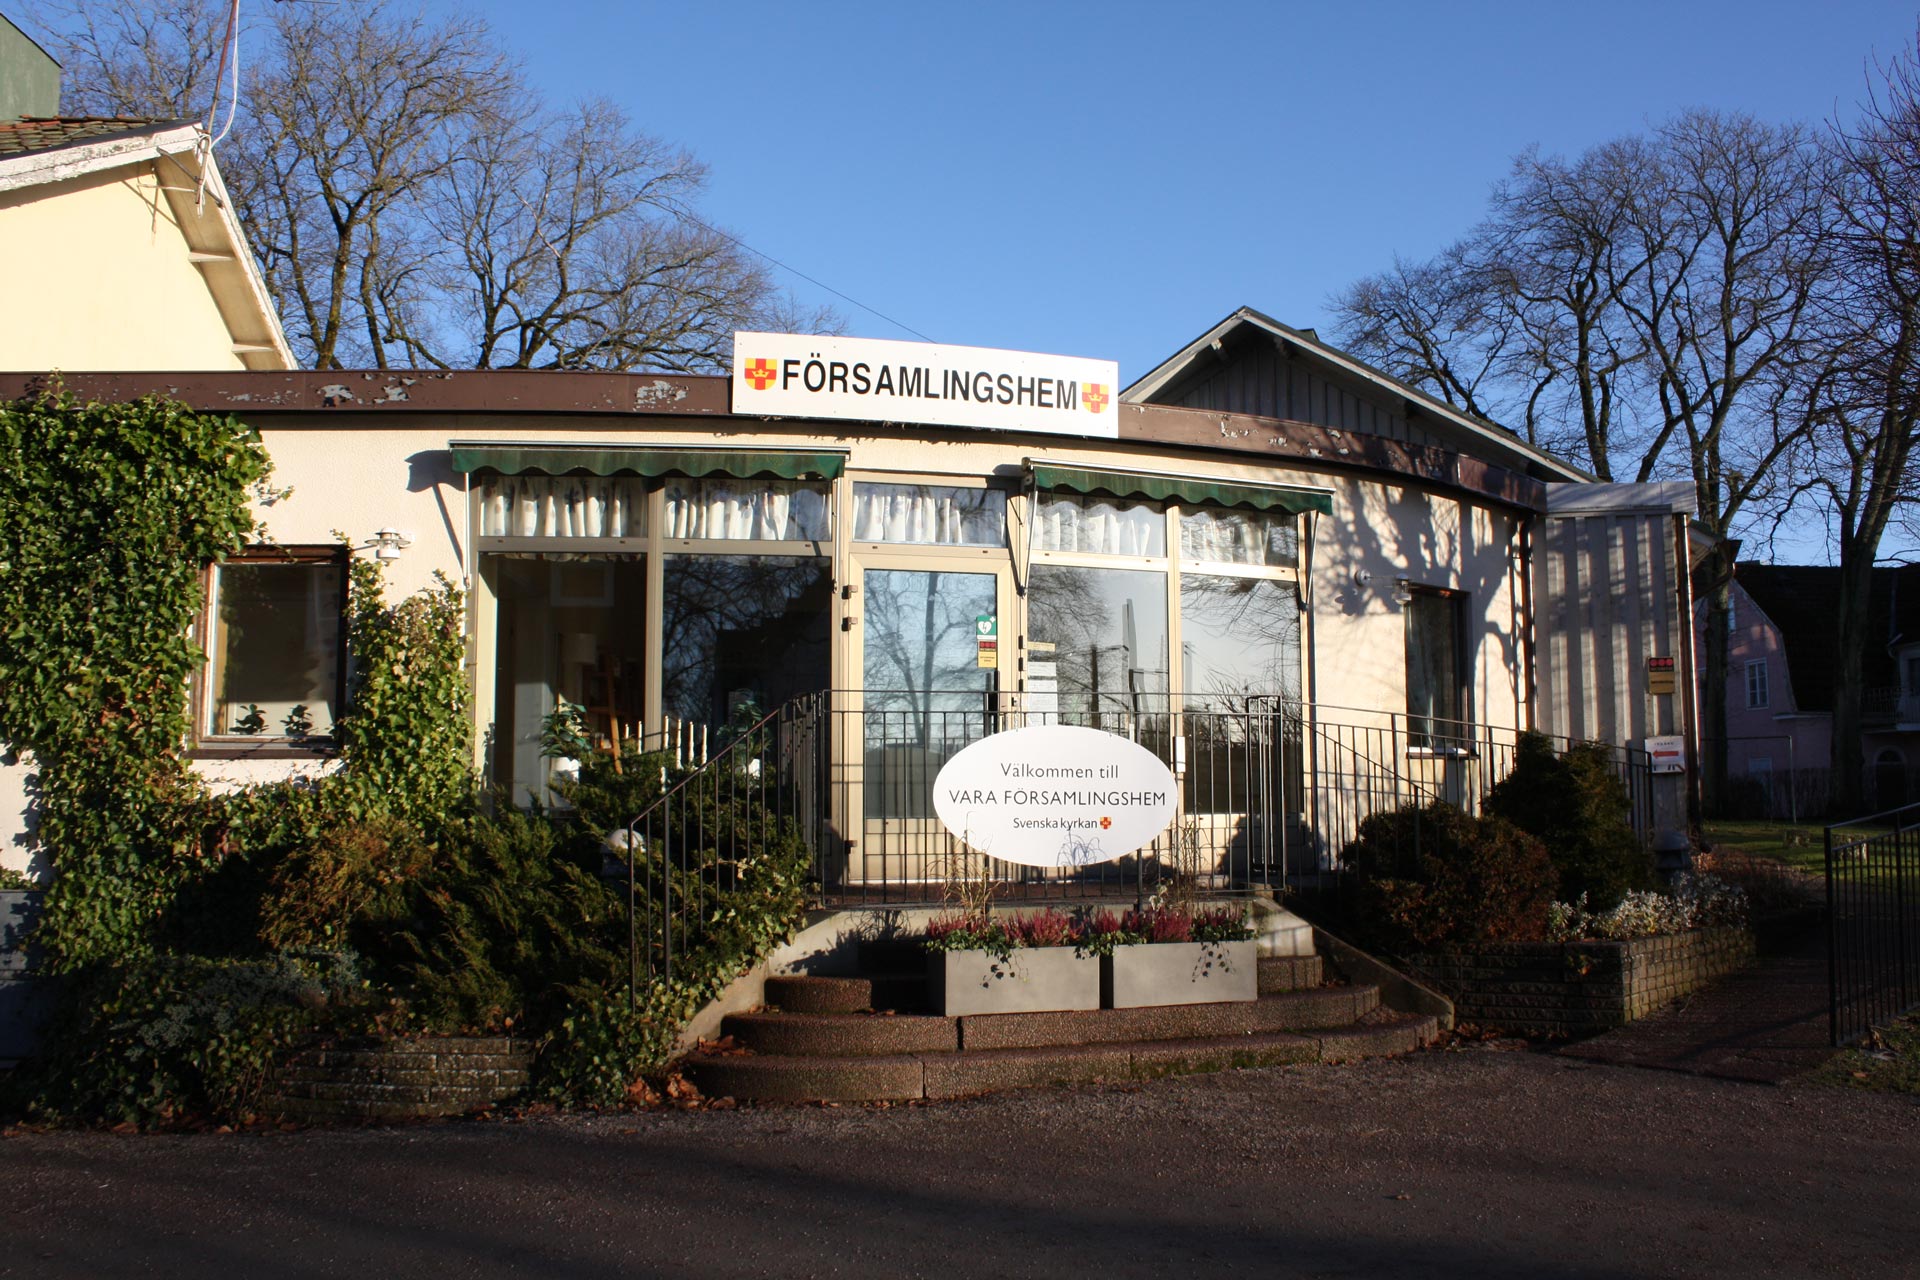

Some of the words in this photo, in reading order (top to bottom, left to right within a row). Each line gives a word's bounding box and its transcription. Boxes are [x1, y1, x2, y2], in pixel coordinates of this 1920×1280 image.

[782, 352, 1077, 411] FÖRSAMLINGSHEM
[1000, 762, 1093, 779] Välkommen
[1099, 764, 1119, 779] till
[948, 789, 998, 805] VARA
[1004, 787, 1166, 806] FÖRSAMLINGSHEM
[1013, 817, 1058, 829] Svenska
[1060, 817, 1098, 831] kyrkan
